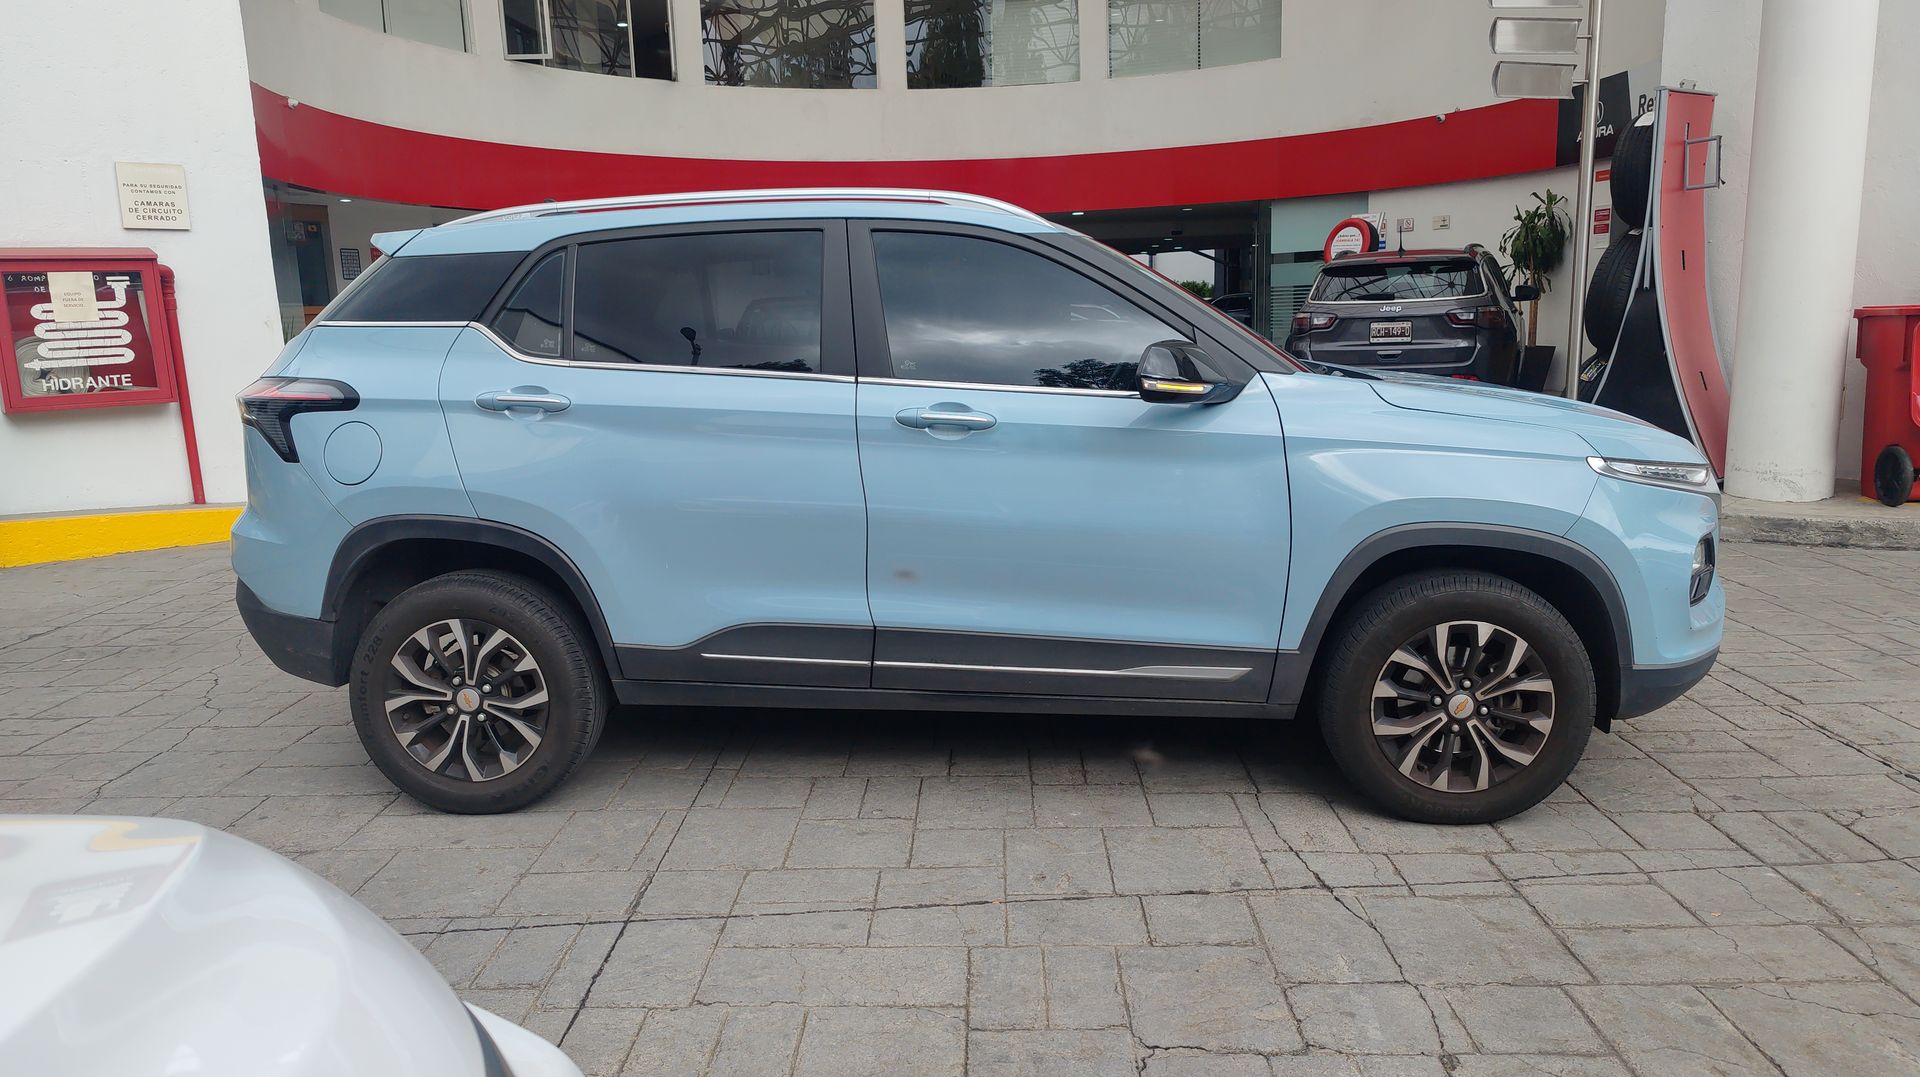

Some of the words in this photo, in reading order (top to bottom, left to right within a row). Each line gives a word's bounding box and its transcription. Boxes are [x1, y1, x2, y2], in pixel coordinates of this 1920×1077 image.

[1638, 93, 1656, 116] Re
[1379, 304, 1402, 313] Jeep
[42, 373, 133, 392] HIDRANTE
